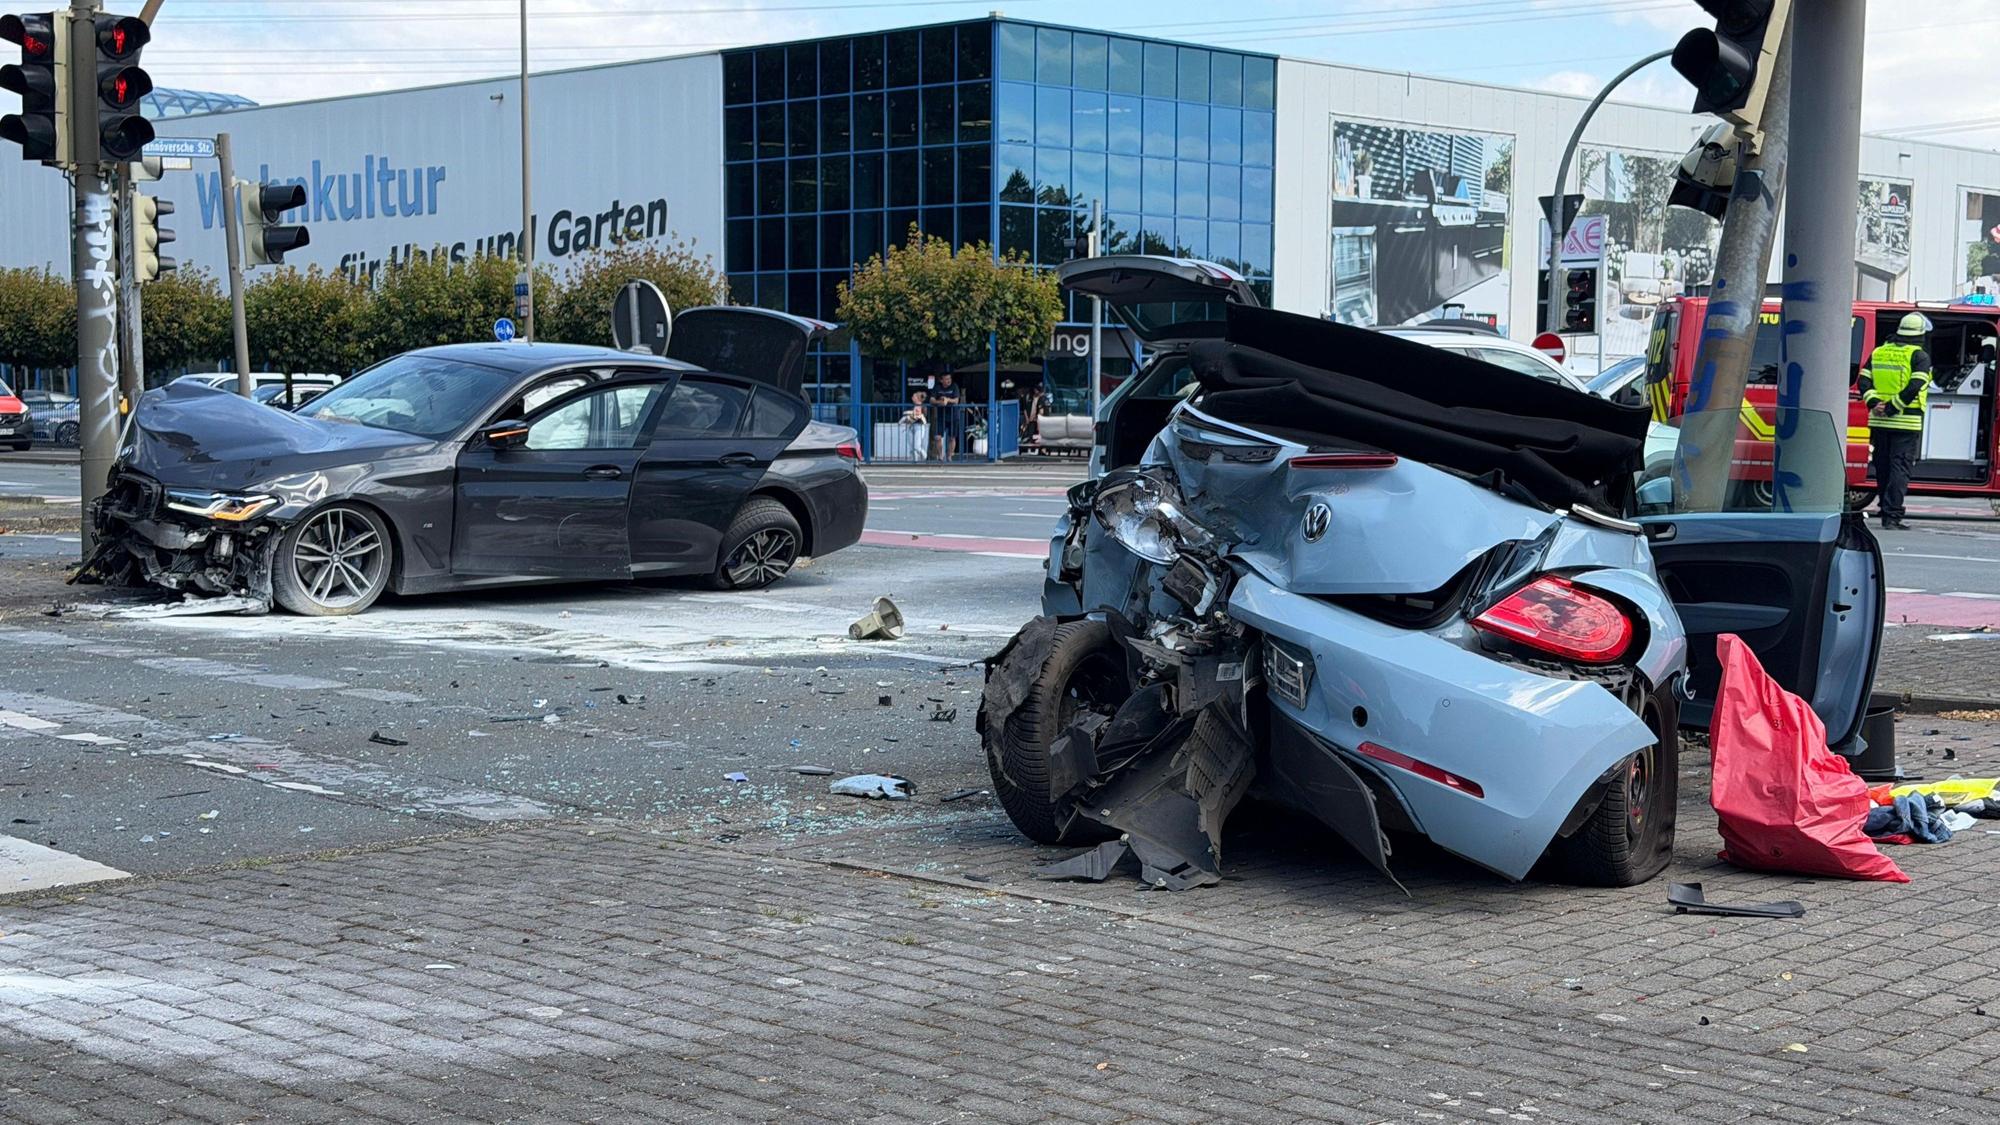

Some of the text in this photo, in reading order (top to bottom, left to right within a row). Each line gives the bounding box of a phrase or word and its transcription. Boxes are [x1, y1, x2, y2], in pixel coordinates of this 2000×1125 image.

[144, 141, 194, 153] annöversche
[195, 154, 446, 230] Wnkultur
[548, 197, 668, 257] Garten
